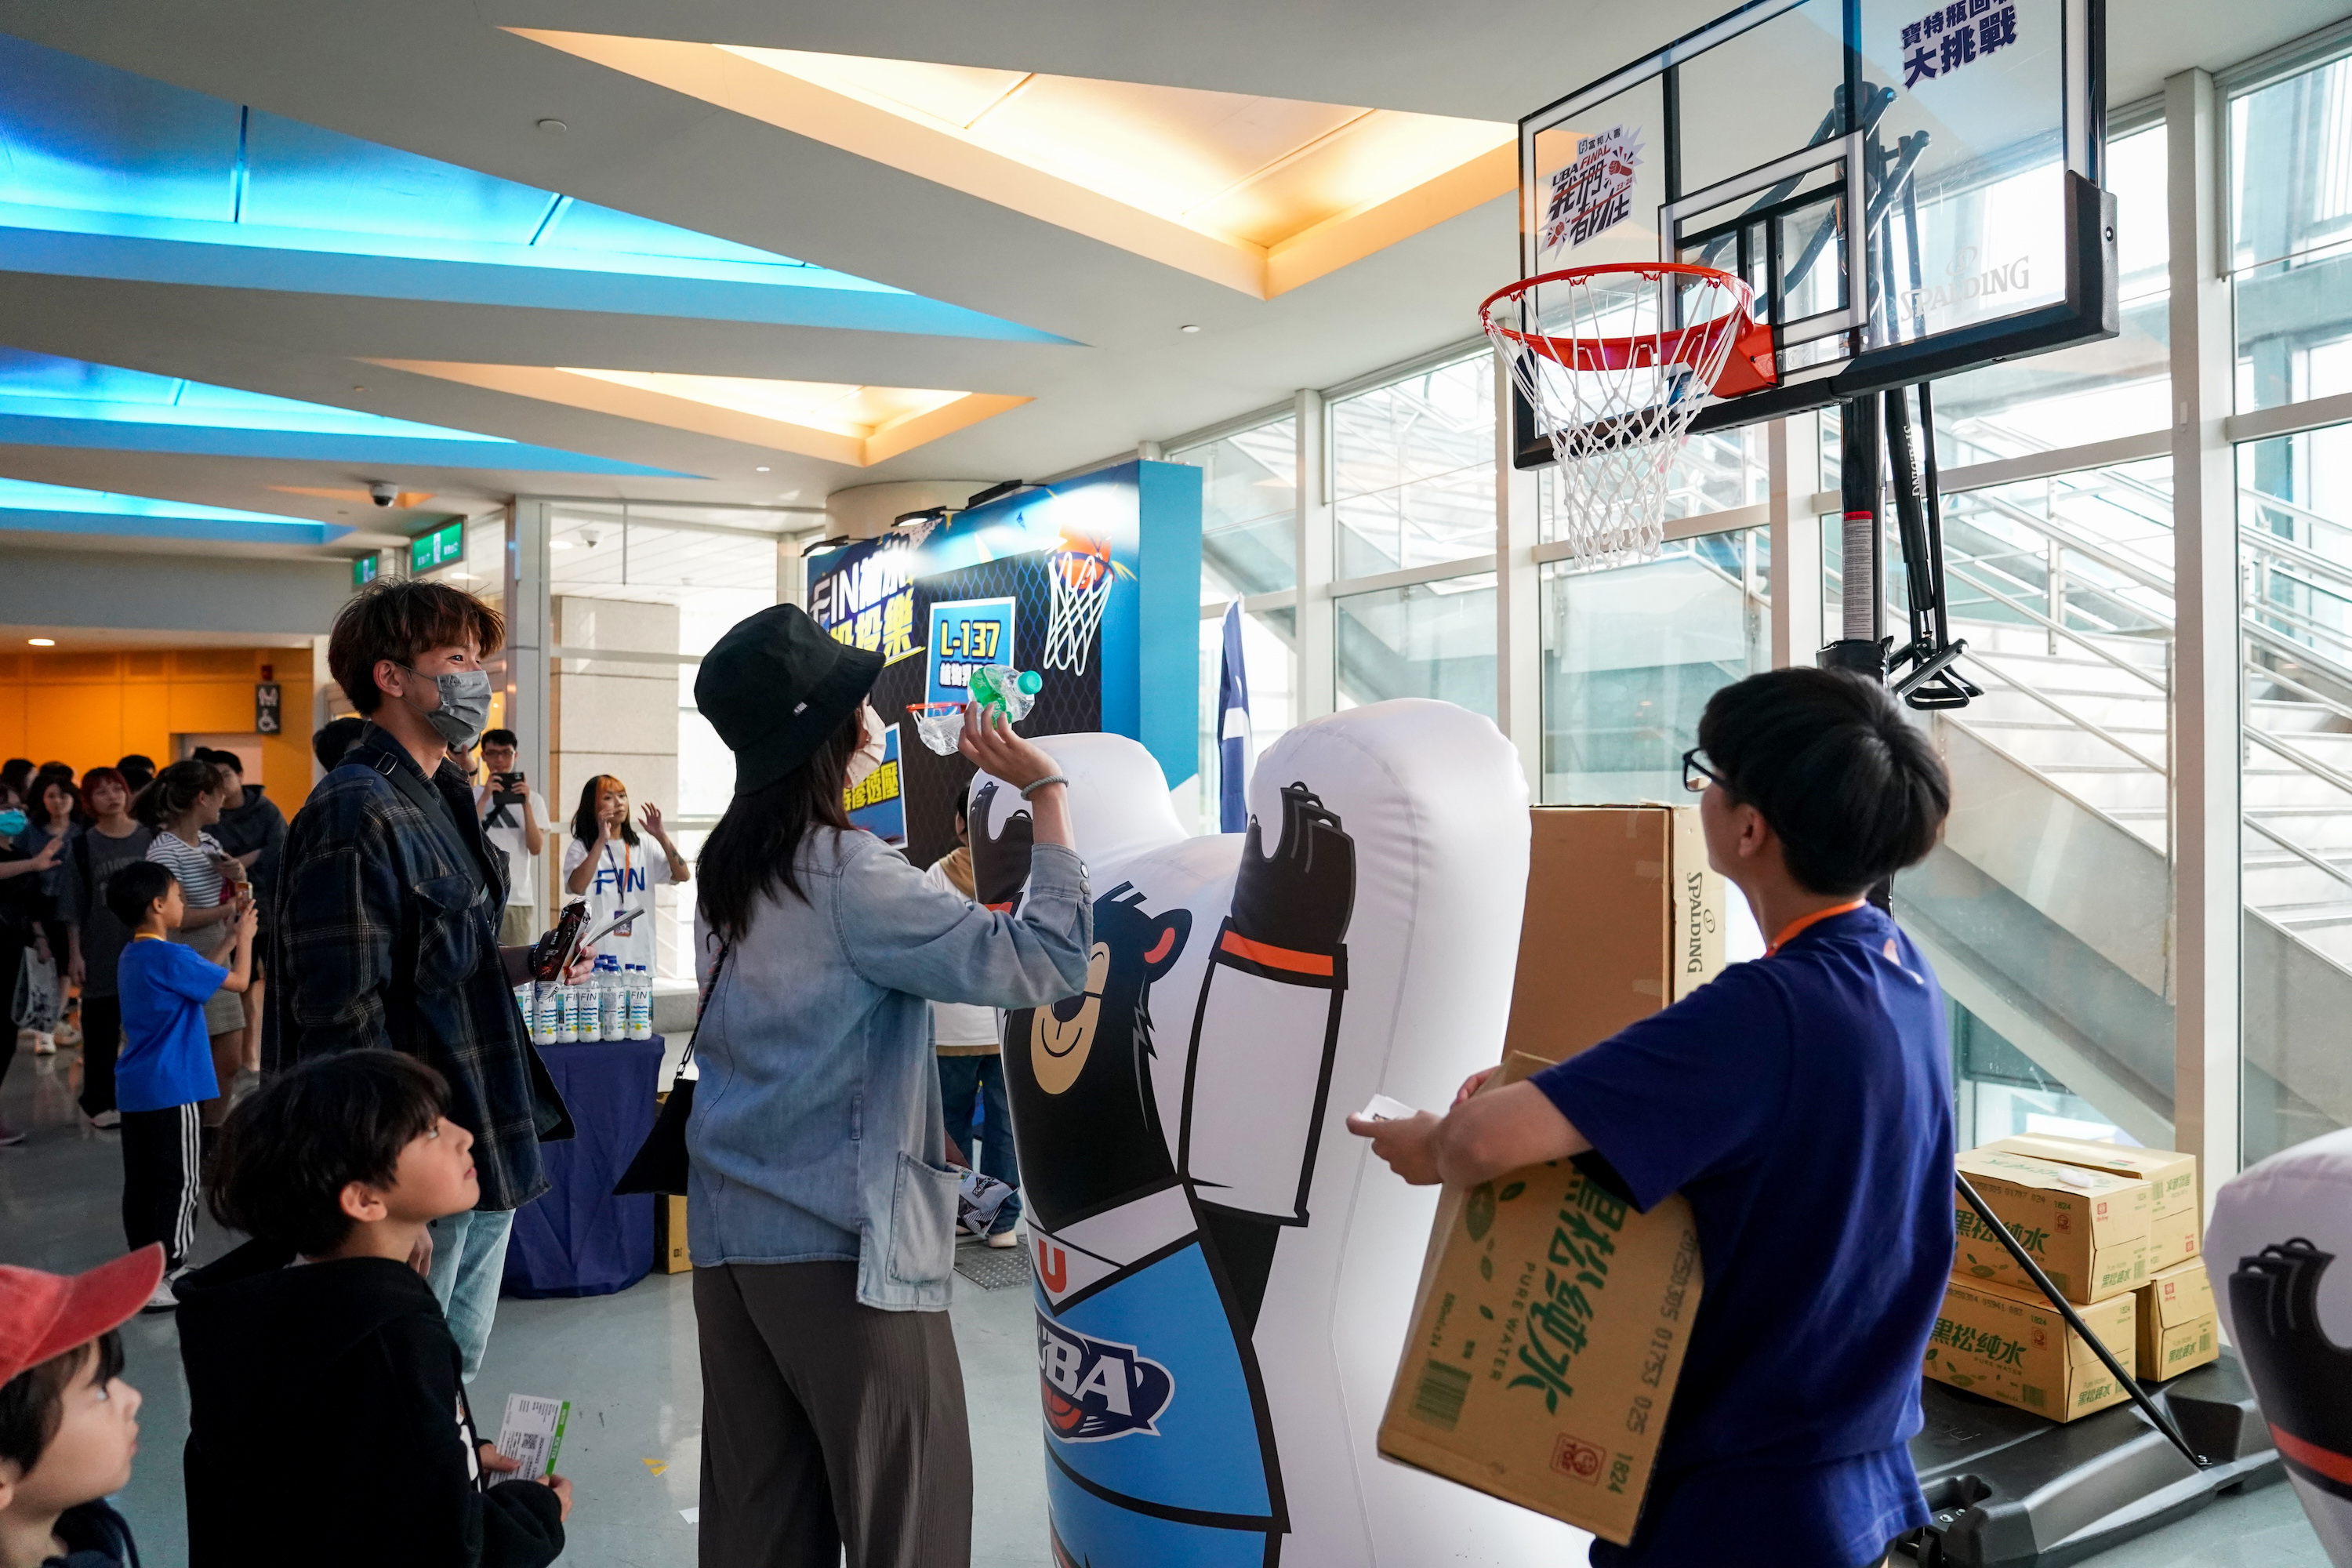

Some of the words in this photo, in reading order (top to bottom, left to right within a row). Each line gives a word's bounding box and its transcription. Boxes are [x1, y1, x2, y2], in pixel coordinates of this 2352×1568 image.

[1904, 5, 2016, 89] 大挑戰
[1588, 127, 1621, 151] 富邦人壽
[1552, 163, 1578, 186] UBA
[1579, 144, 1611, 171] FINAL
[1900, 255, 2029, 322] SPALDING
[940, 619, 1001, 658] L-137
[592, 866, 645, 895] FIN
[1687, 872, 1703, 973] SPALDING
[580, 993, 597, 1002] FIN
[631, 991, 648, 1000] FIN
[2054, 1200, 2071, 1210] 1824
[1039, 1239, 1067, 1294] U
[1512, 1261, 1537, 1311] PURE
[1038, 1323, 1133, 1417] UBA
[1490, 1317, 1519, 1381] WATER
[1627, 1396, 1653, 1436] 025
[1607, 1452, 1634, 1495] 1824
